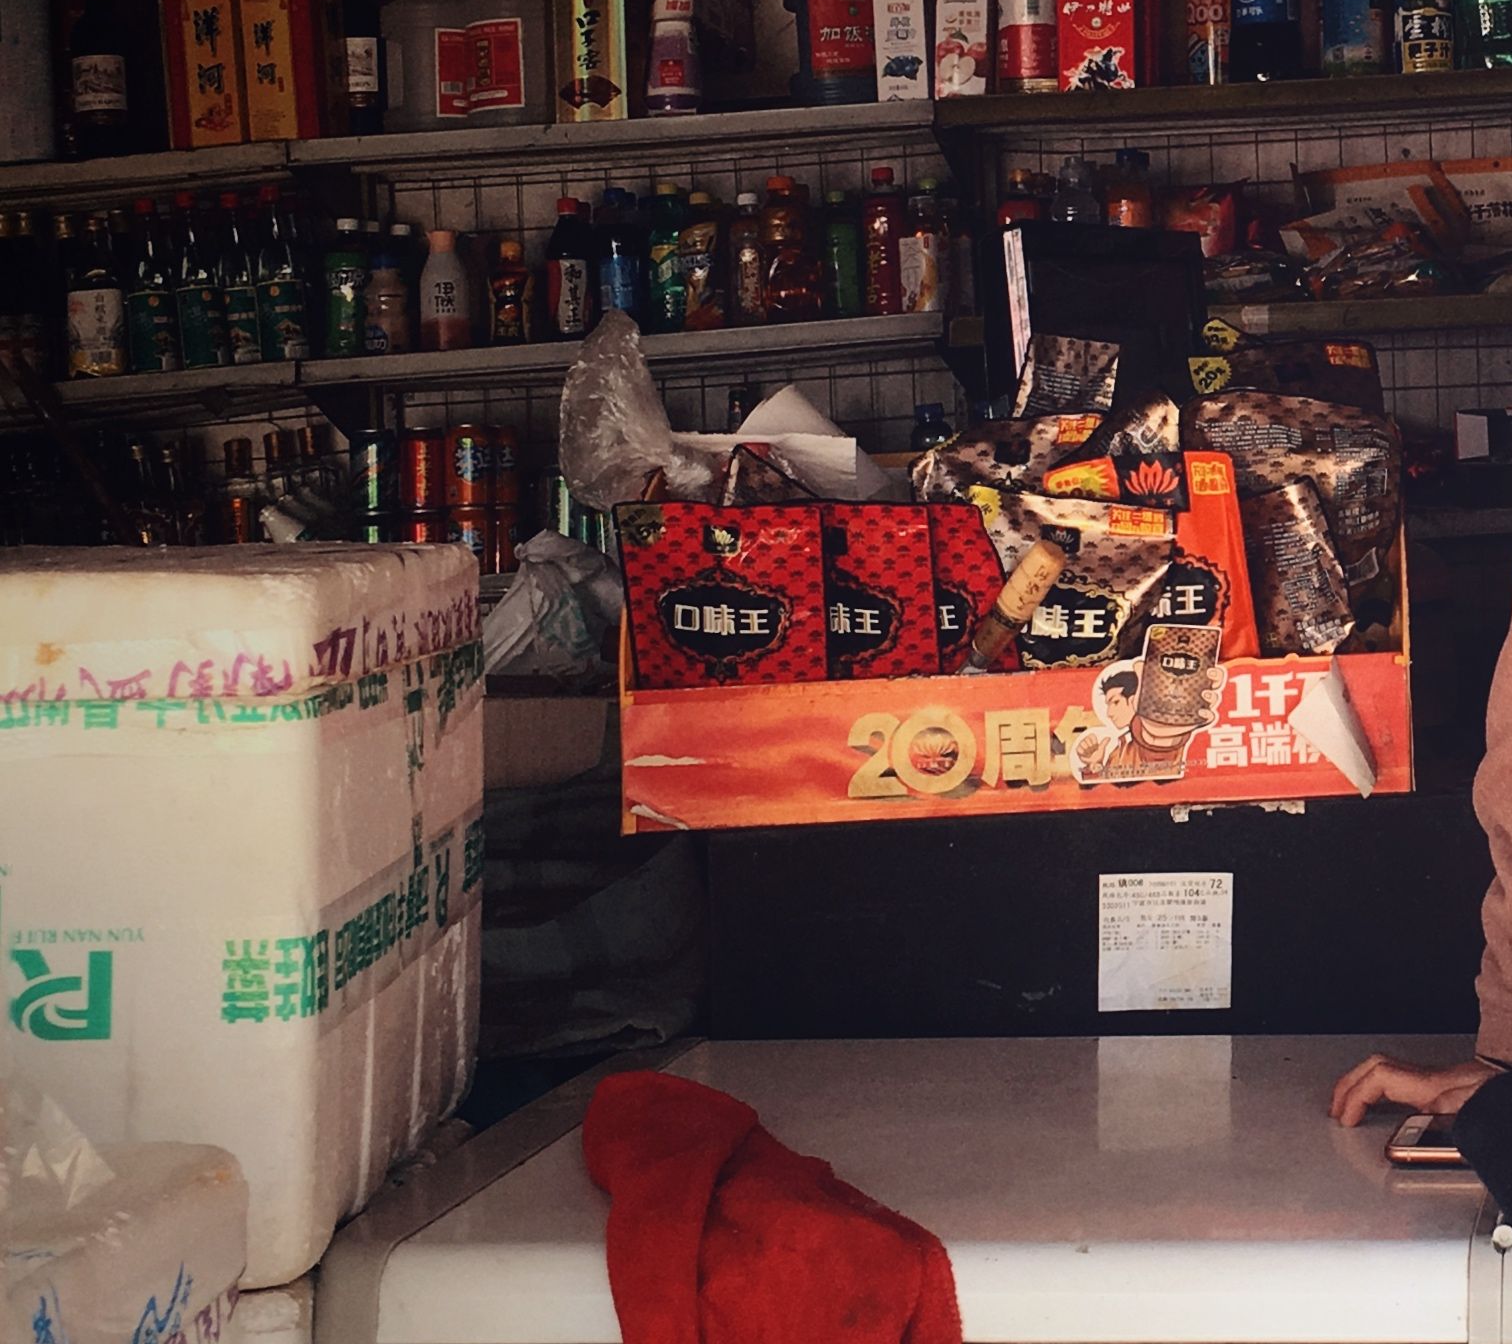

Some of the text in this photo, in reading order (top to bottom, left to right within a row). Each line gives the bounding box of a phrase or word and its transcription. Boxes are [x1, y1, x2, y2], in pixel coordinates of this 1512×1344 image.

[193, 6, 225, 94] 洋河
[254, 20, 278, 84] 洋河
[674, 603, 770, 636] 口味王
[1020, 605, 1107, 639] 味王
[1162, 657, 1197, 670] 口味王
